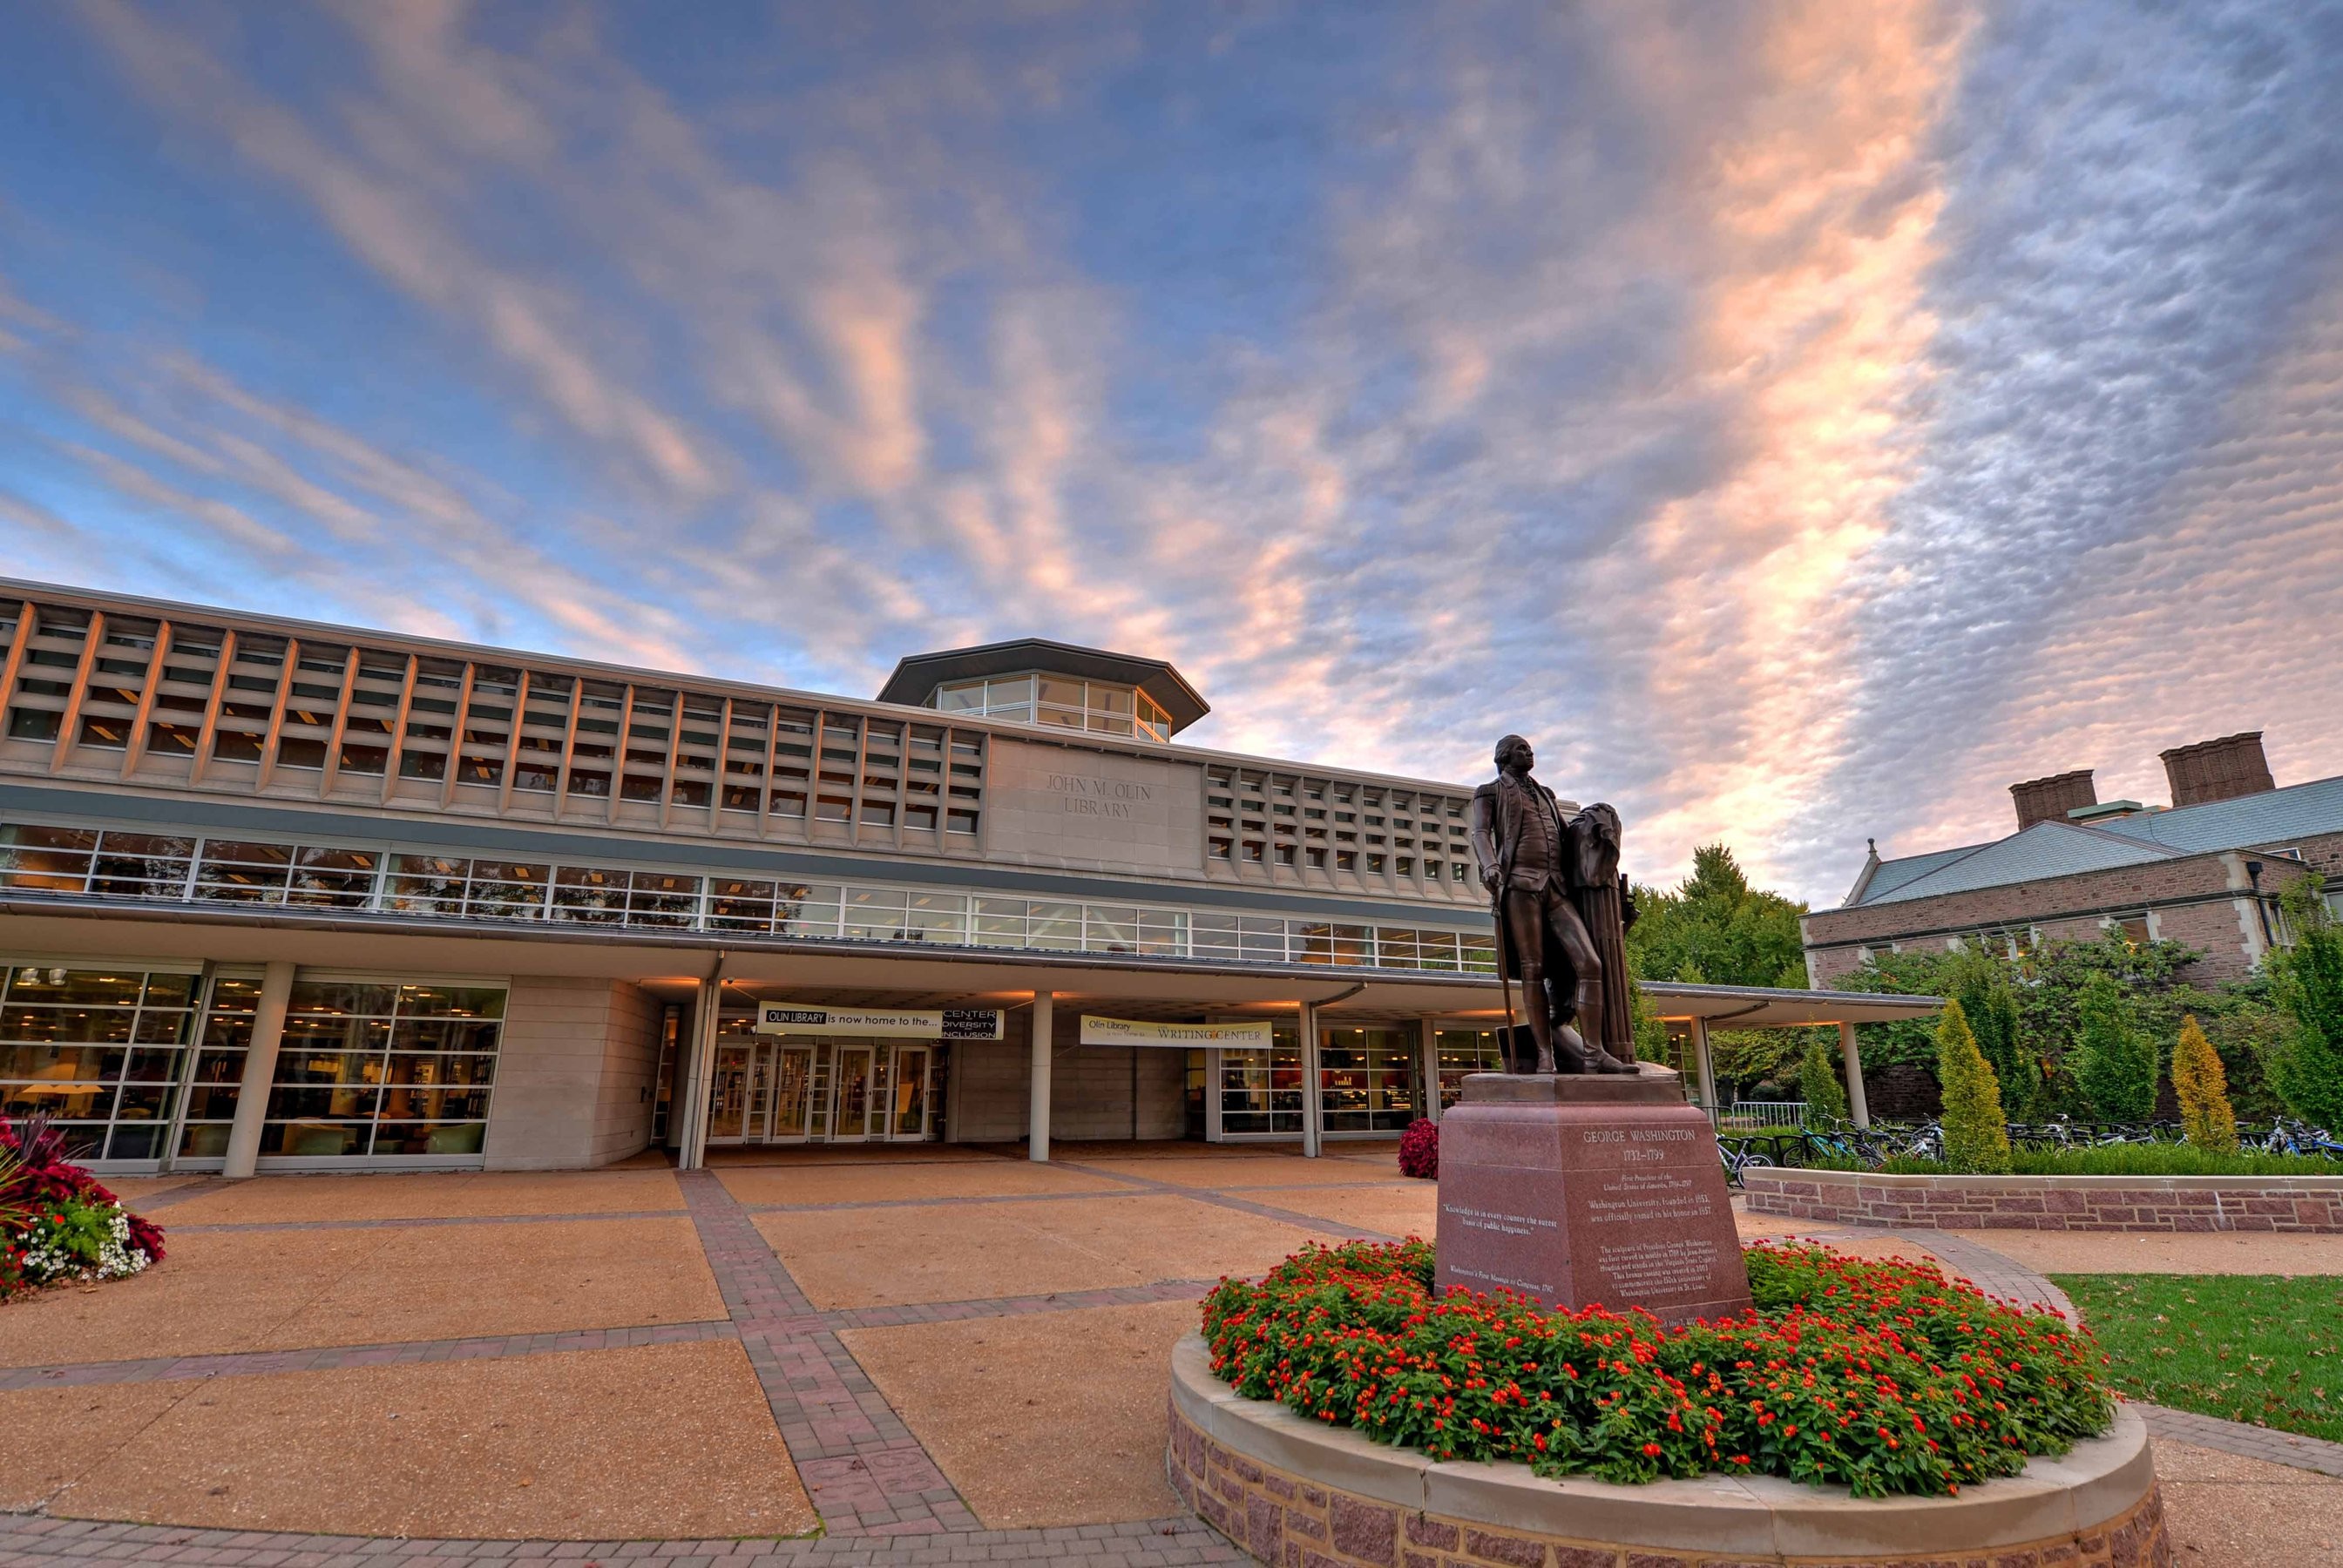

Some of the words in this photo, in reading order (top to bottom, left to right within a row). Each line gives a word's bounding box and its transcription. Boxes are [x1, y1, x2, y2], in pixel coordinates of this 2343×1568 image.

[1046, 774, 1086, 792] JOHN
[1115, 783, 1151, 801] OLIN
[1065, 797, 1132, 818] LIBRARY
[769, 1011, 789, 1022] OLIN
[791, 1012, 823, 1024] LIBRARY
[828, 1014, 836, 1023] is
[865, 1016, 896, 1025] home
[899, 1017, 909, 1026] to
[943, 1010, 996, 1018] CENTER
[1089, 1020, 1105, 1029] Olin
[1107, 1022, 1130, 1031] Library
[1157, 1028, 1212, 1039] WRITING
[1215, 1030, 1261, 1040] CENTER
[1583, 1131, 1625, 1143] GEORGE
[1630, 1129, 1696, 1142] WASHINGTON
[1588, 1200, 1626, 1210] Washington
[1627, 1198, 1661, 1208] University,
[1662, 1196, 1686, 1205] founded
[1480, 1209, 1486, 1218] in
[1487, 1212, 1501, 1220] every
[1503, 1213, 1525, 1224] country
[1527, 1214, 1536, 1225] the
[1538, 1219, 1557, 1227] surest
[1604, 1212, 1632, 1224] officially
[1634, 1210, 1653, 1220] named
[1663, 1210, 1672, 1219] his
[1673, 1209, 1690, 1218] honor
[1484, 1221, 1500, 1231] public
[1620, 1288, 1650, 1297] Washington
